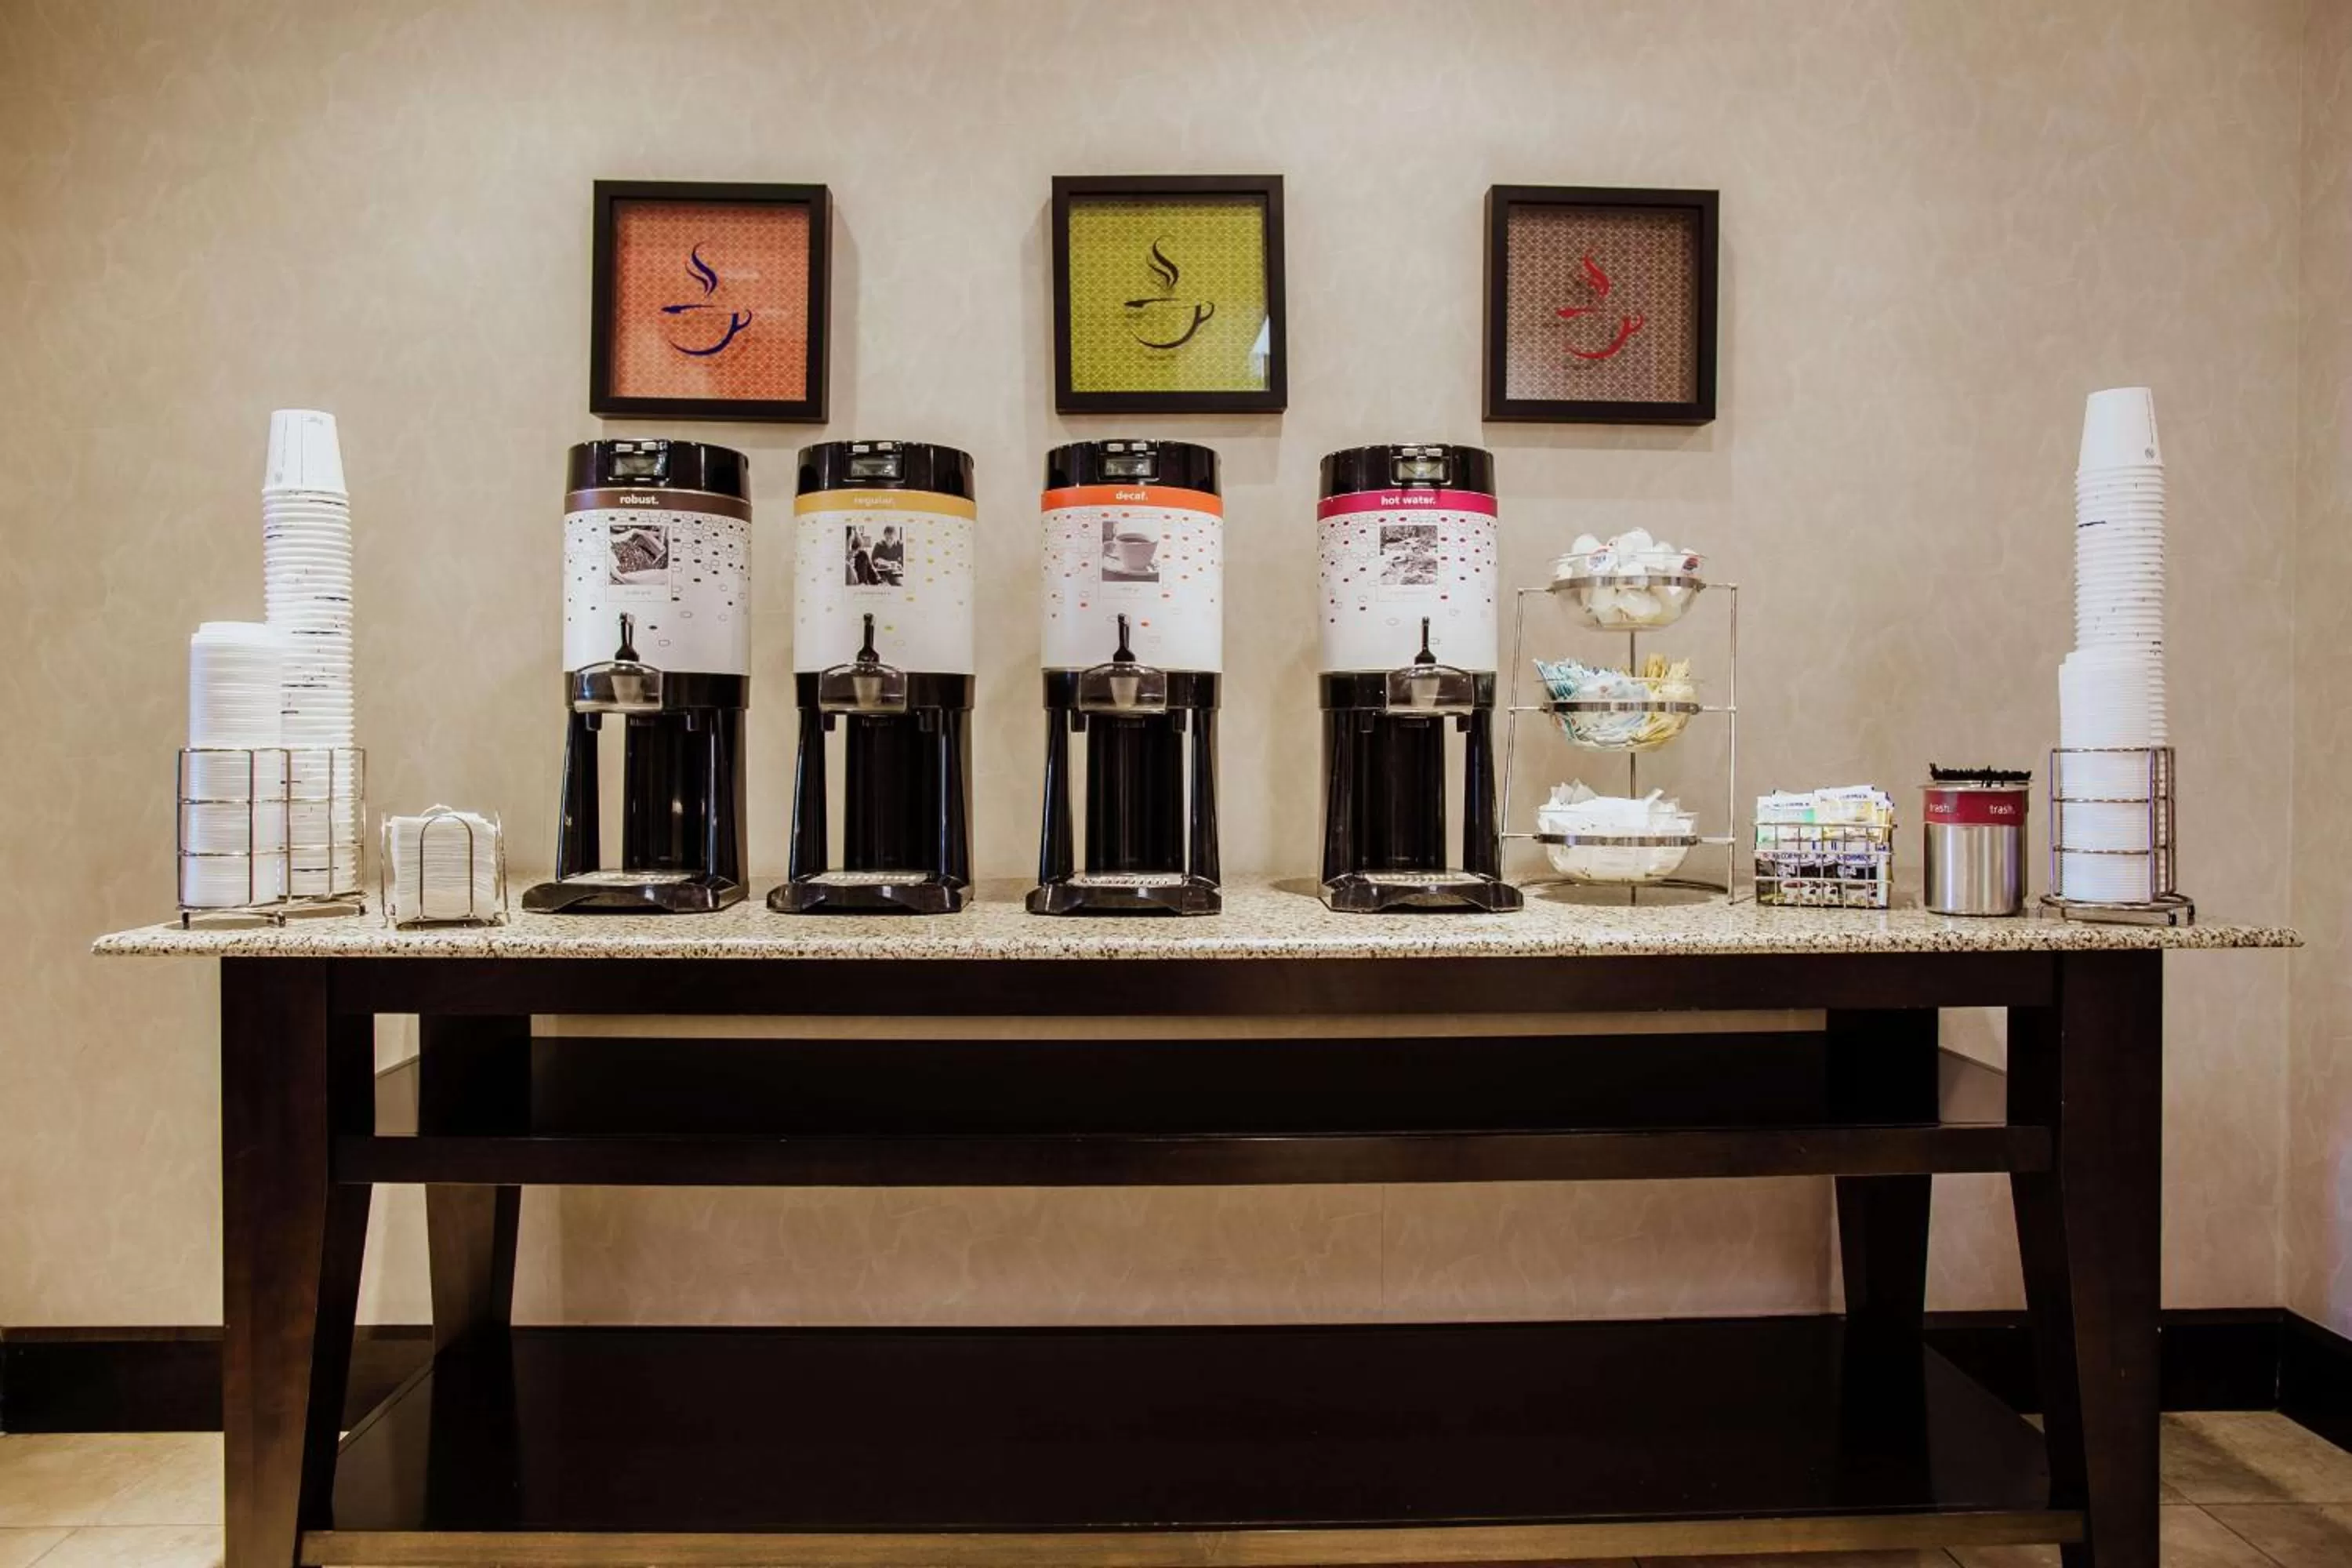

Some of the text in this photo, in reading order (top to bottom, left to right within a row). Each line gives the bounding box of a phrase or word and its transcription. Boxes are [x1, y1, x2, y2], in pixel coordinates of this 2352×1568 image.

[619, 494, 659, 504] robust.
[1116, 491, 1148, 501] decaf.
[1381, 495, 1436, 506] hot water.
